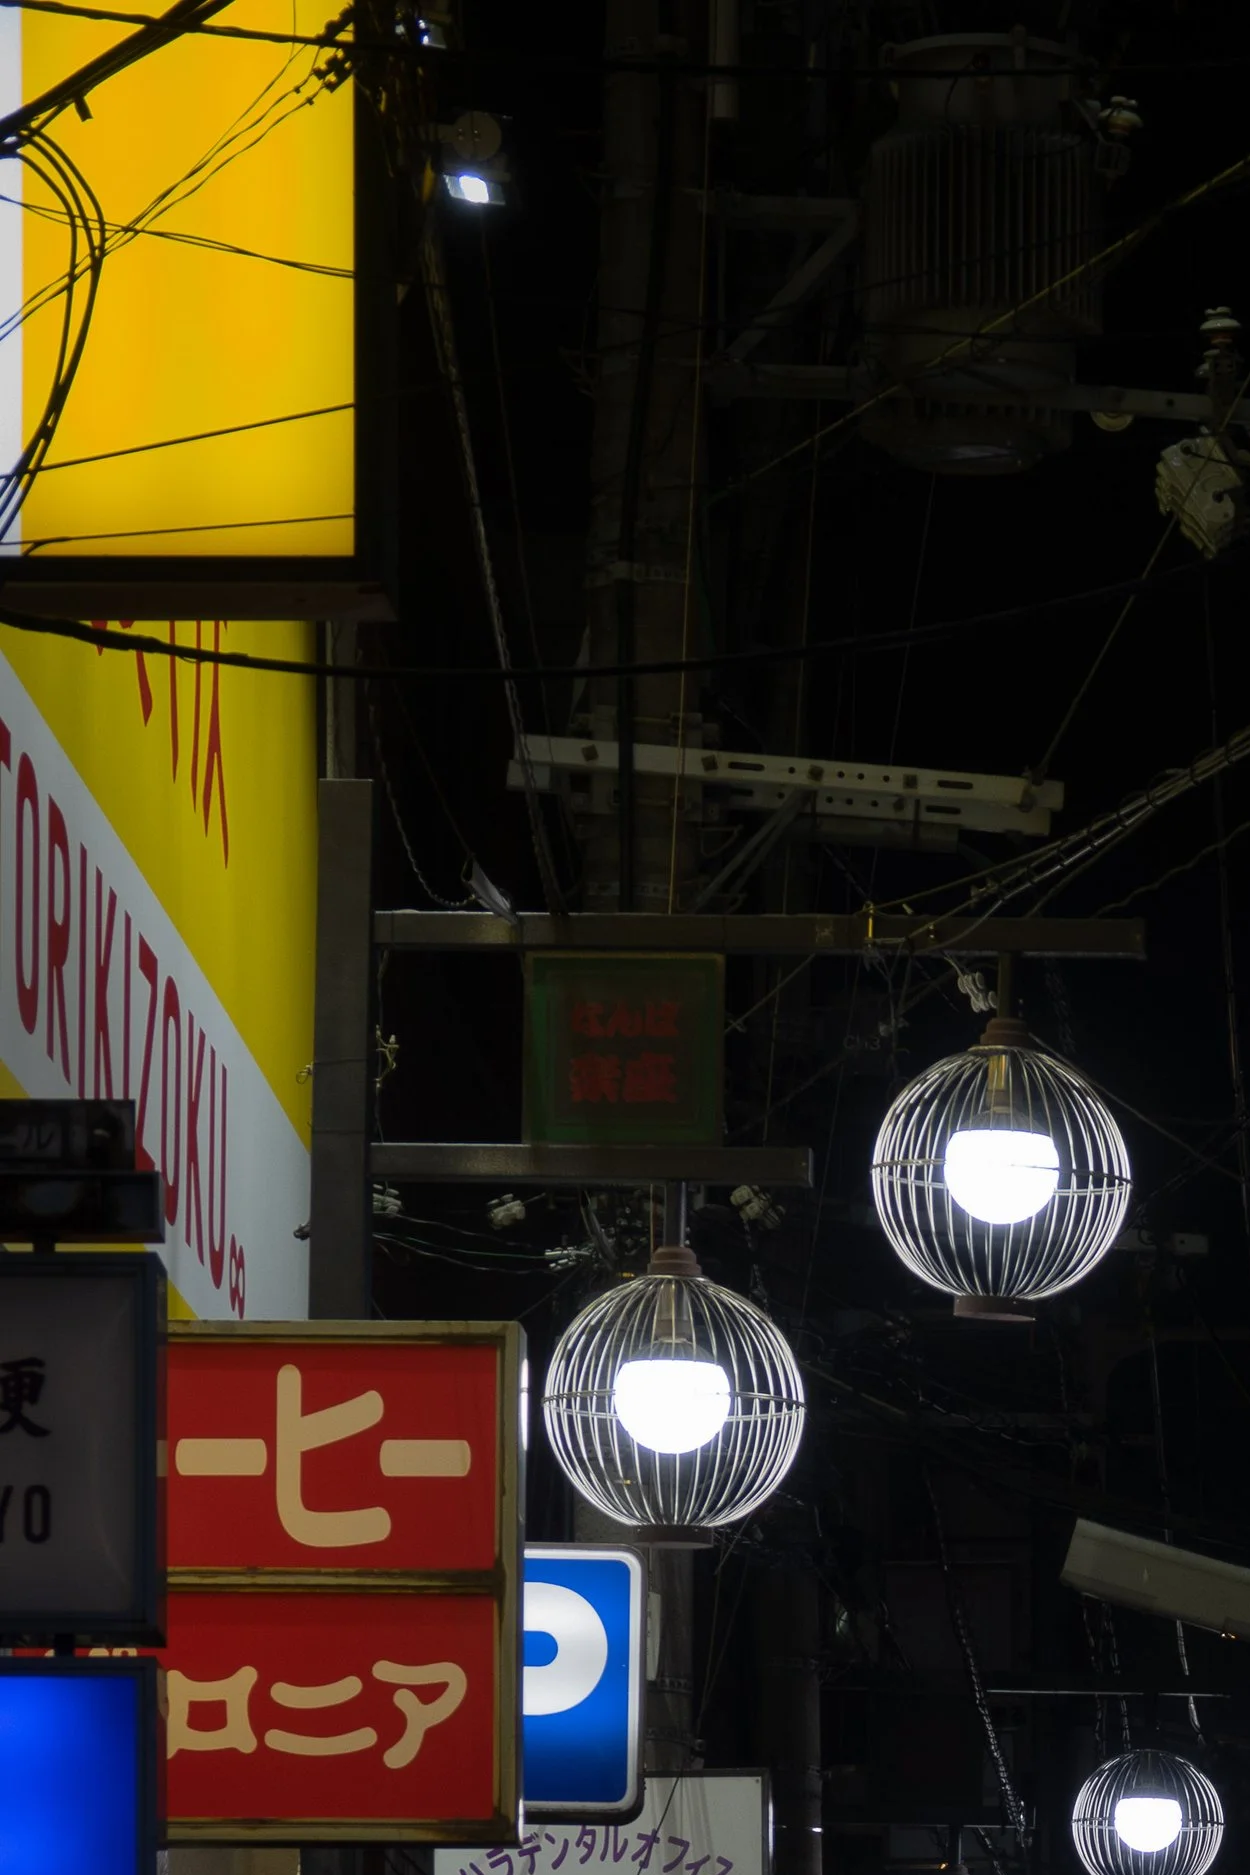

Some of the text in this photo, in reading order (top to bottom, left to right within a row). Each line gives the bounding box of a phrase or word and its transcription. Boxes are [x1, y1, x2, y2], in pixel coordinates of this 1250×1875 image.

[0, 715, 230, 1291] ORIKIZOKU
[160, 1363, 471, 1548] ーヒー
[165, 1658, 468, 1770] ロニア
